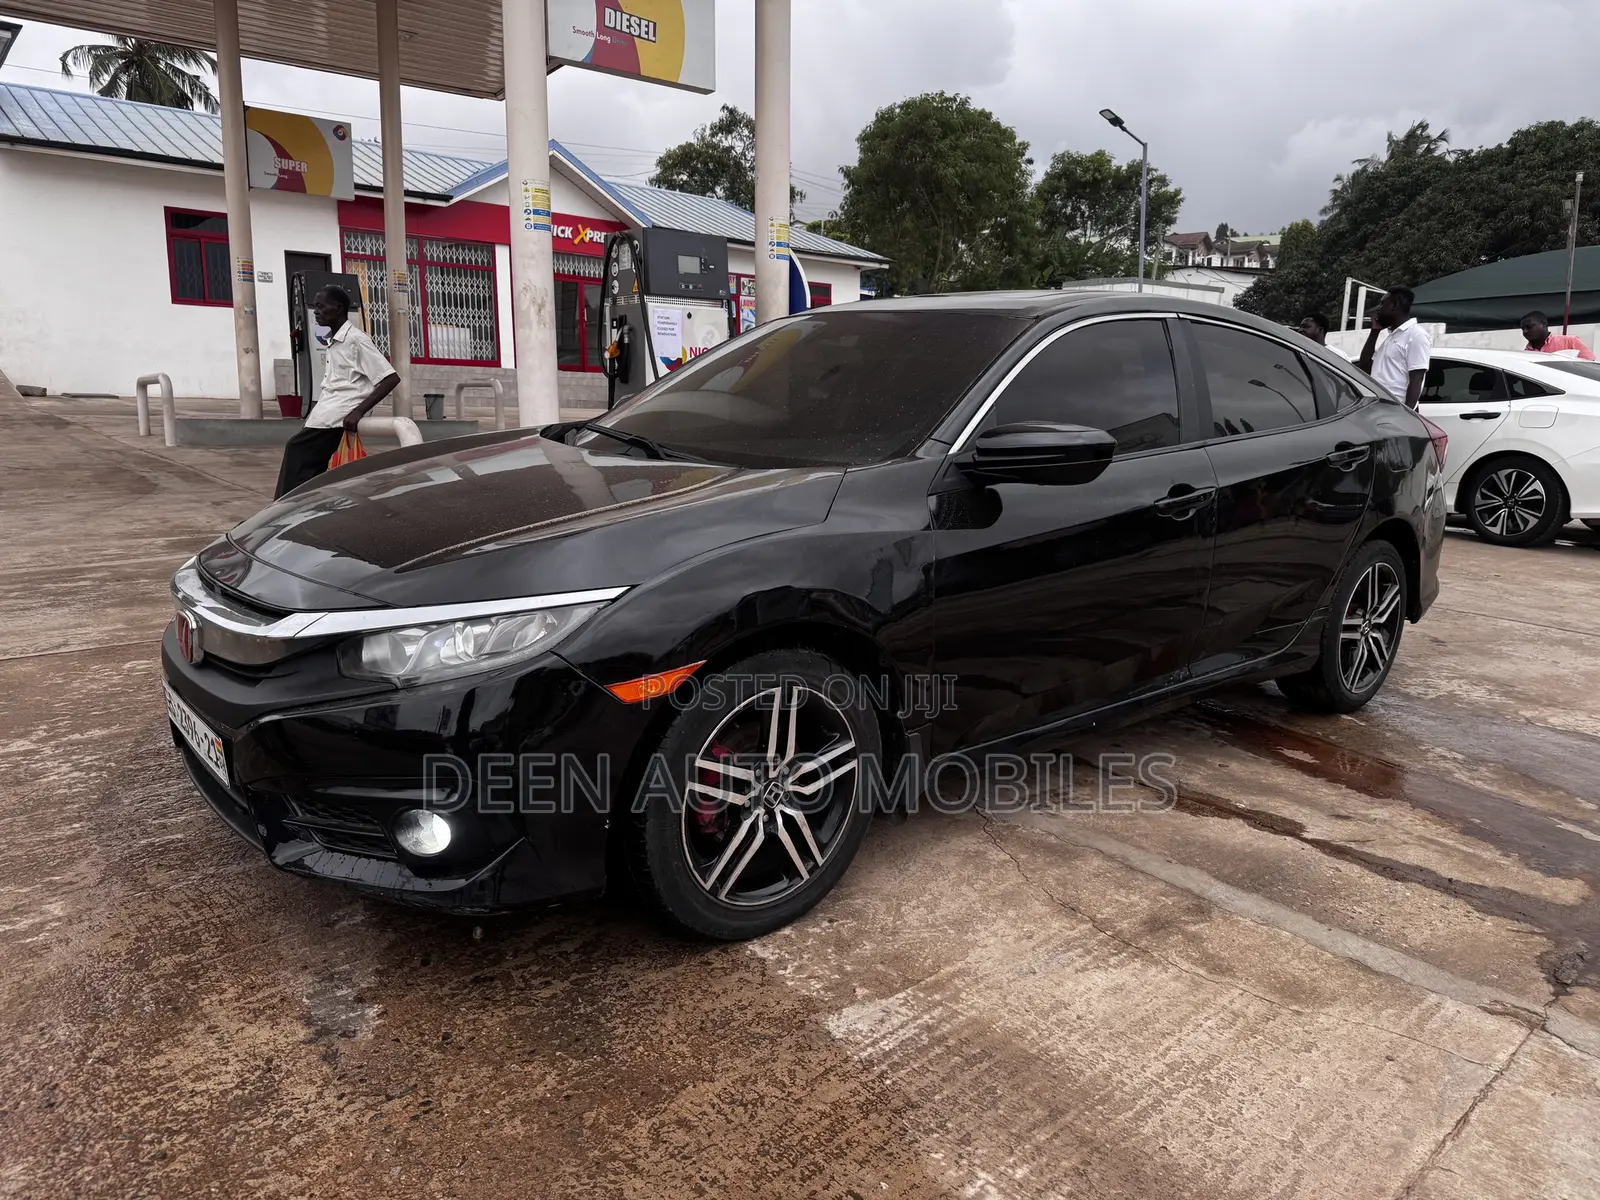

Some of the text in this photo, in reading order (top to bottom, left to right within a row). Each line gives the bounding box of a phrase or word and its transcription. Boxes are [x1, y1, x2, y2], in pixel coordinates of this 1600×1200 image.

[604, 7, 656, 41] DIESEL
[572, 26, 595, 38] Smooth
[596, 31, 611, 44] Long
[273, 157, 308, 172] SUPER
[551, 223, 607, 245] ICK XPRE
